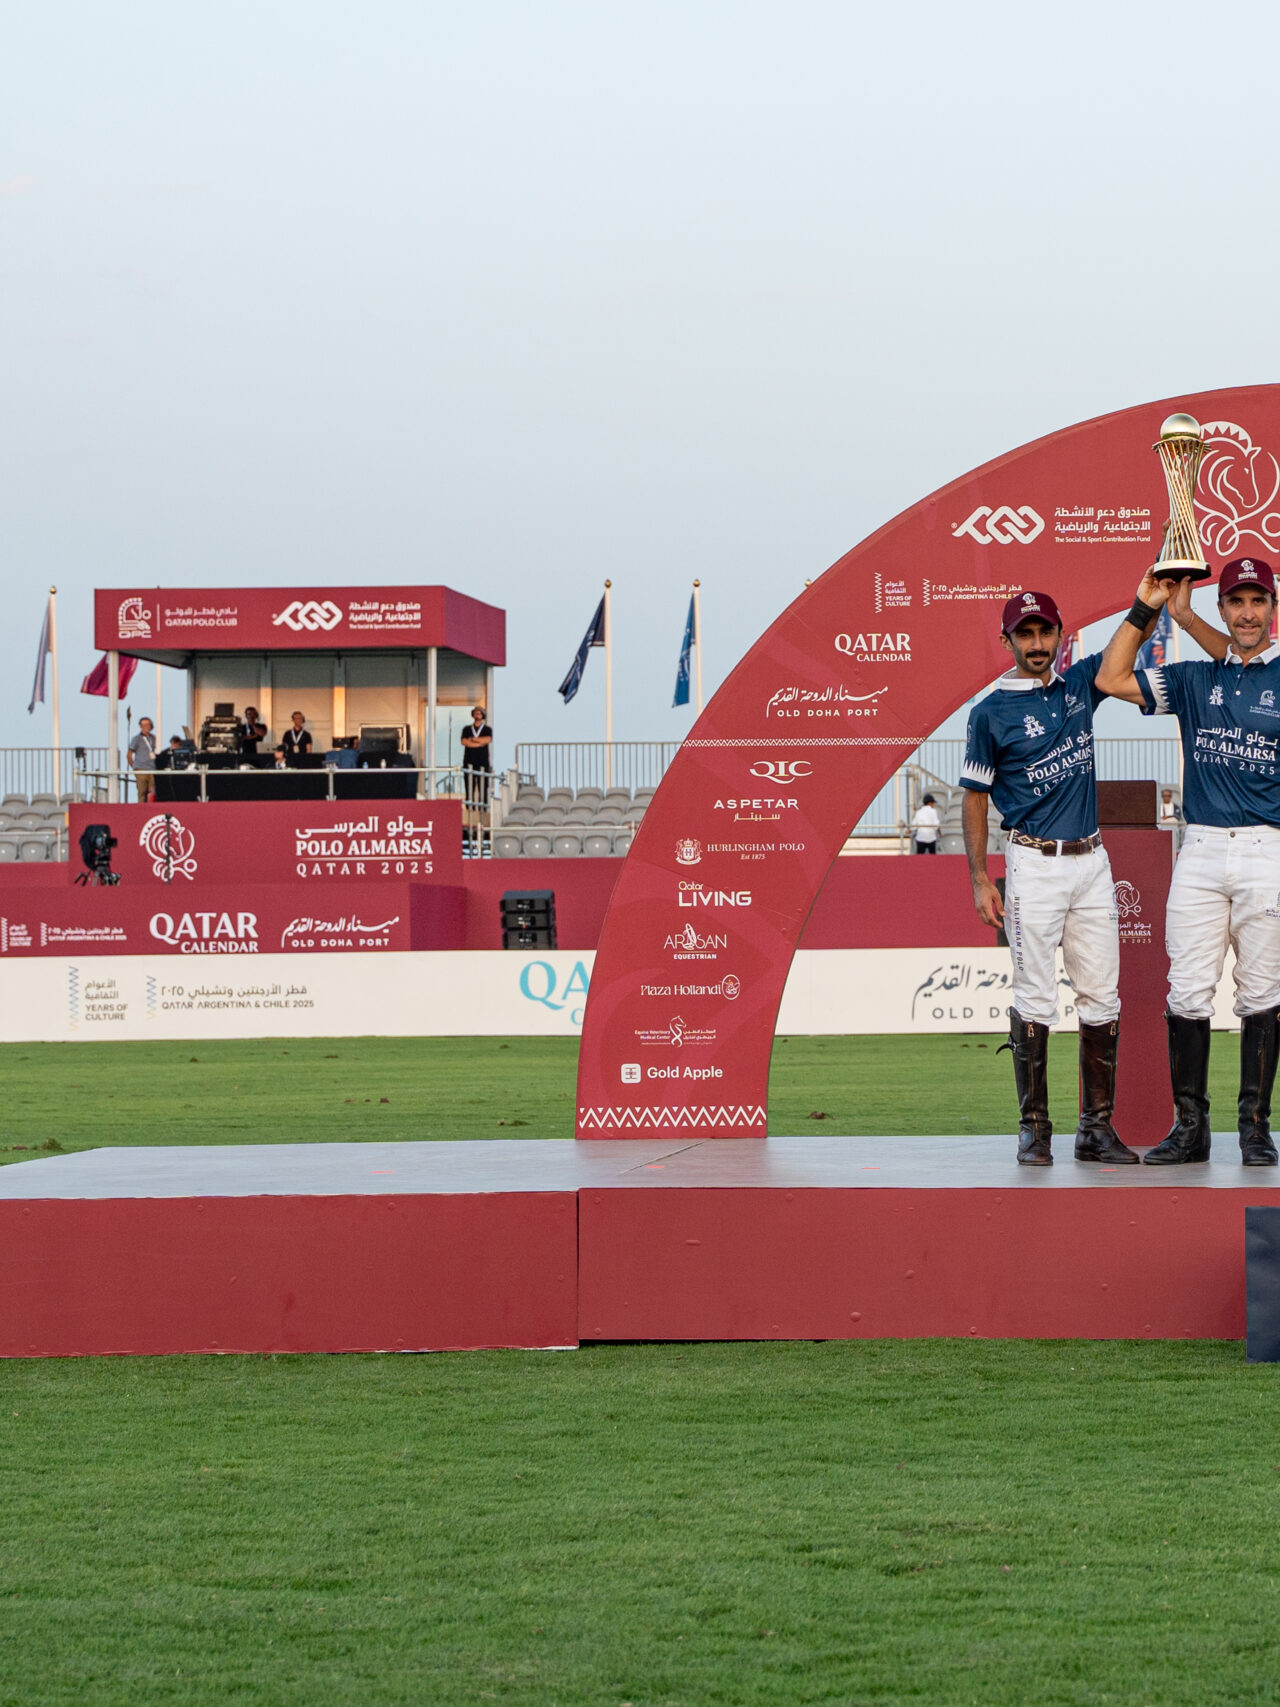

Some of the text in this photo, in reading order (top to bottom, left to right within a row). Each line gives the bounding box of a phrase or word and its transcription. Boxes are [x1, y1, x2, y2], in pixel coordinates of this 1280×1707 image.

[1096, 506, 1151, 521] صندوق دعم
[1087, 536, 1102, 544] Sport
[165, 618, 238, 627] QATAR POLO CLUB
[834, 633, 912, 656] QATAR
[856, 654, 912, 662] CALENDAR
[807, 709, 840, 717] DOHA
[1218, 741, 1276, 761] ALMARSA
[749, 760, 813, 784] QIC
[1027, 762, 1060, 783] POLO
[1239, 761, 1275, 775] 2025
[713, 799, 799, 810] ASPETAR
[295, 816, 433, 839] بولو المرسى
[296, 839, 433, 856] POLO ALMARSA
[707, 843, 805, 852] HURLINGHAM POLO
[296, 861, 433, 878] QATAR 2025
[678, 881, 704, 891] Qatar
[678, 891, 752, 907] LIVING
[149, 912, 259, 945] QATAR
[180, 941, 259, 954] CALENDAR
[291, 938, 390, 947] OLD DOHA PORT
[188, 985, 233, 999] وتشيلي
[285, 985, 307, 996] قطر
[640, 984, 721, 996] Plaza Hollandi
[85, 1004, 115, 1012] YEARS
[161, 1000, 314, 1010] QATAR ARGENTINA & CHILE 2025
[85, 1012, 125, 1021] CULTURE
[932, 1007, 974, 1019] OLD
[647, 1066, 723, 1080] Gold Apple
